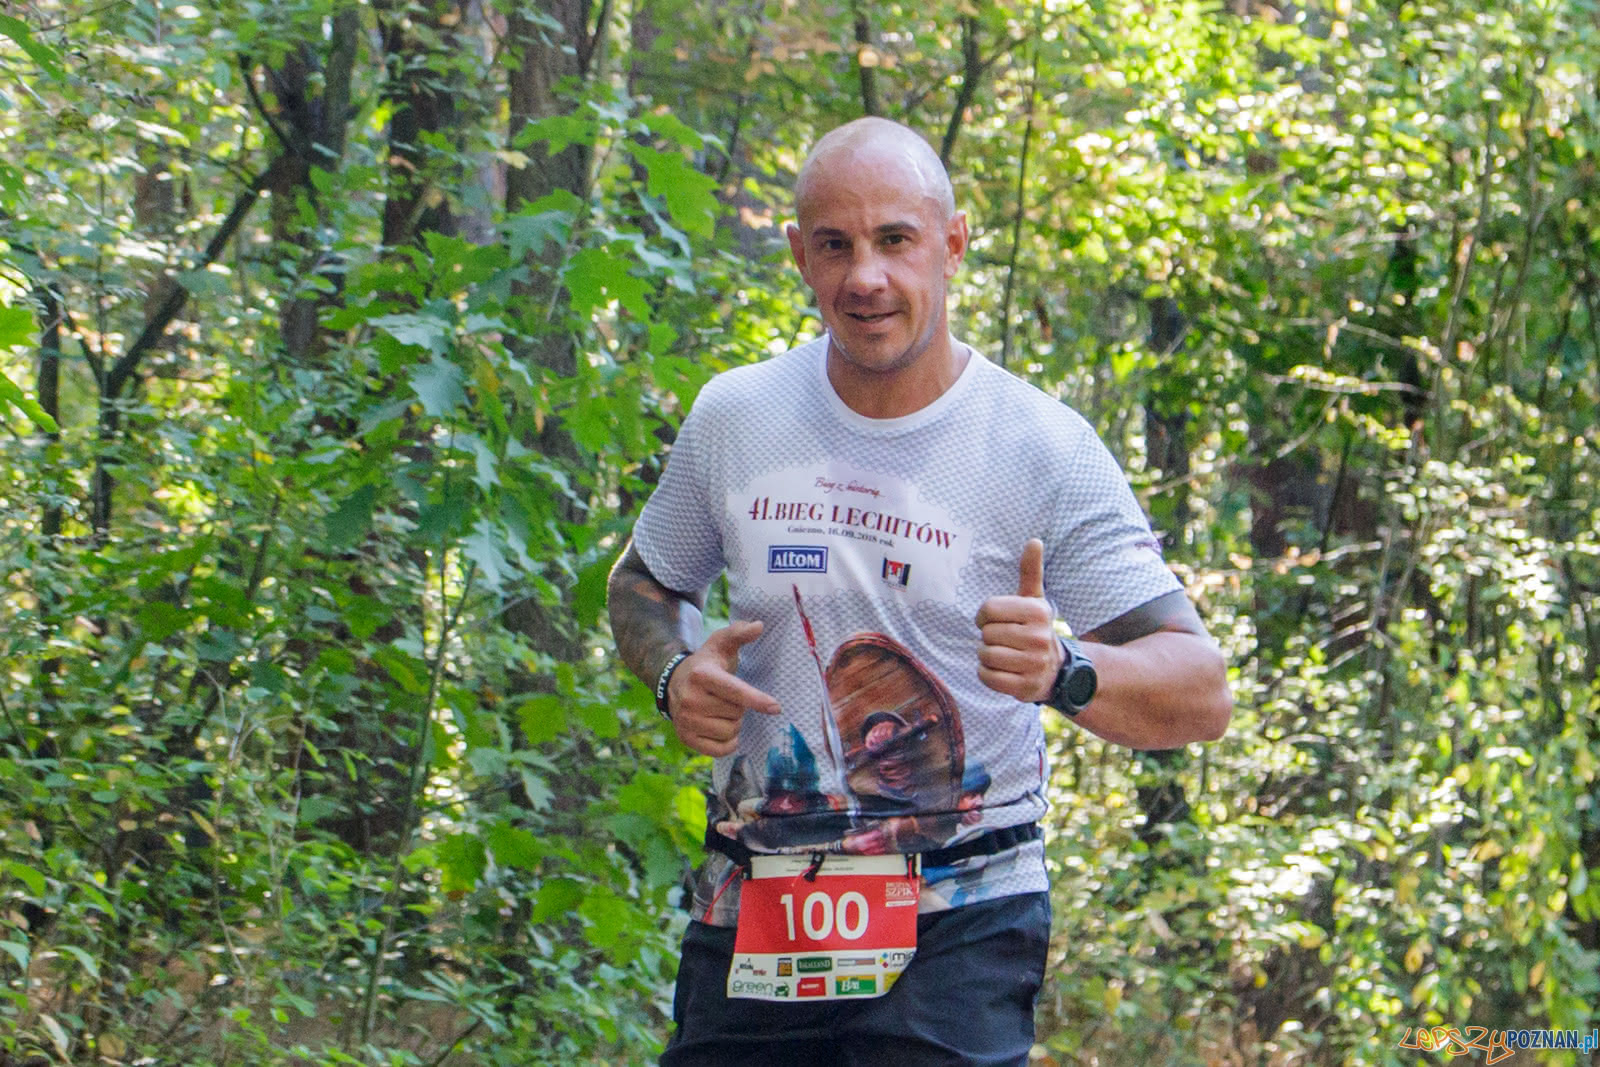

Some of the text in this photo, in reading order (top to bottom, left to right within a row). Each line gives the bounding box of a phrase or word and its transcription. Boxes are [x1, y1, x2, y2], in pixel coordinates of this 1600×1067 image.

[748, 496, 957, 549] 41.BIEG LECHITÓW
[780, 891, 870, 941] 100
